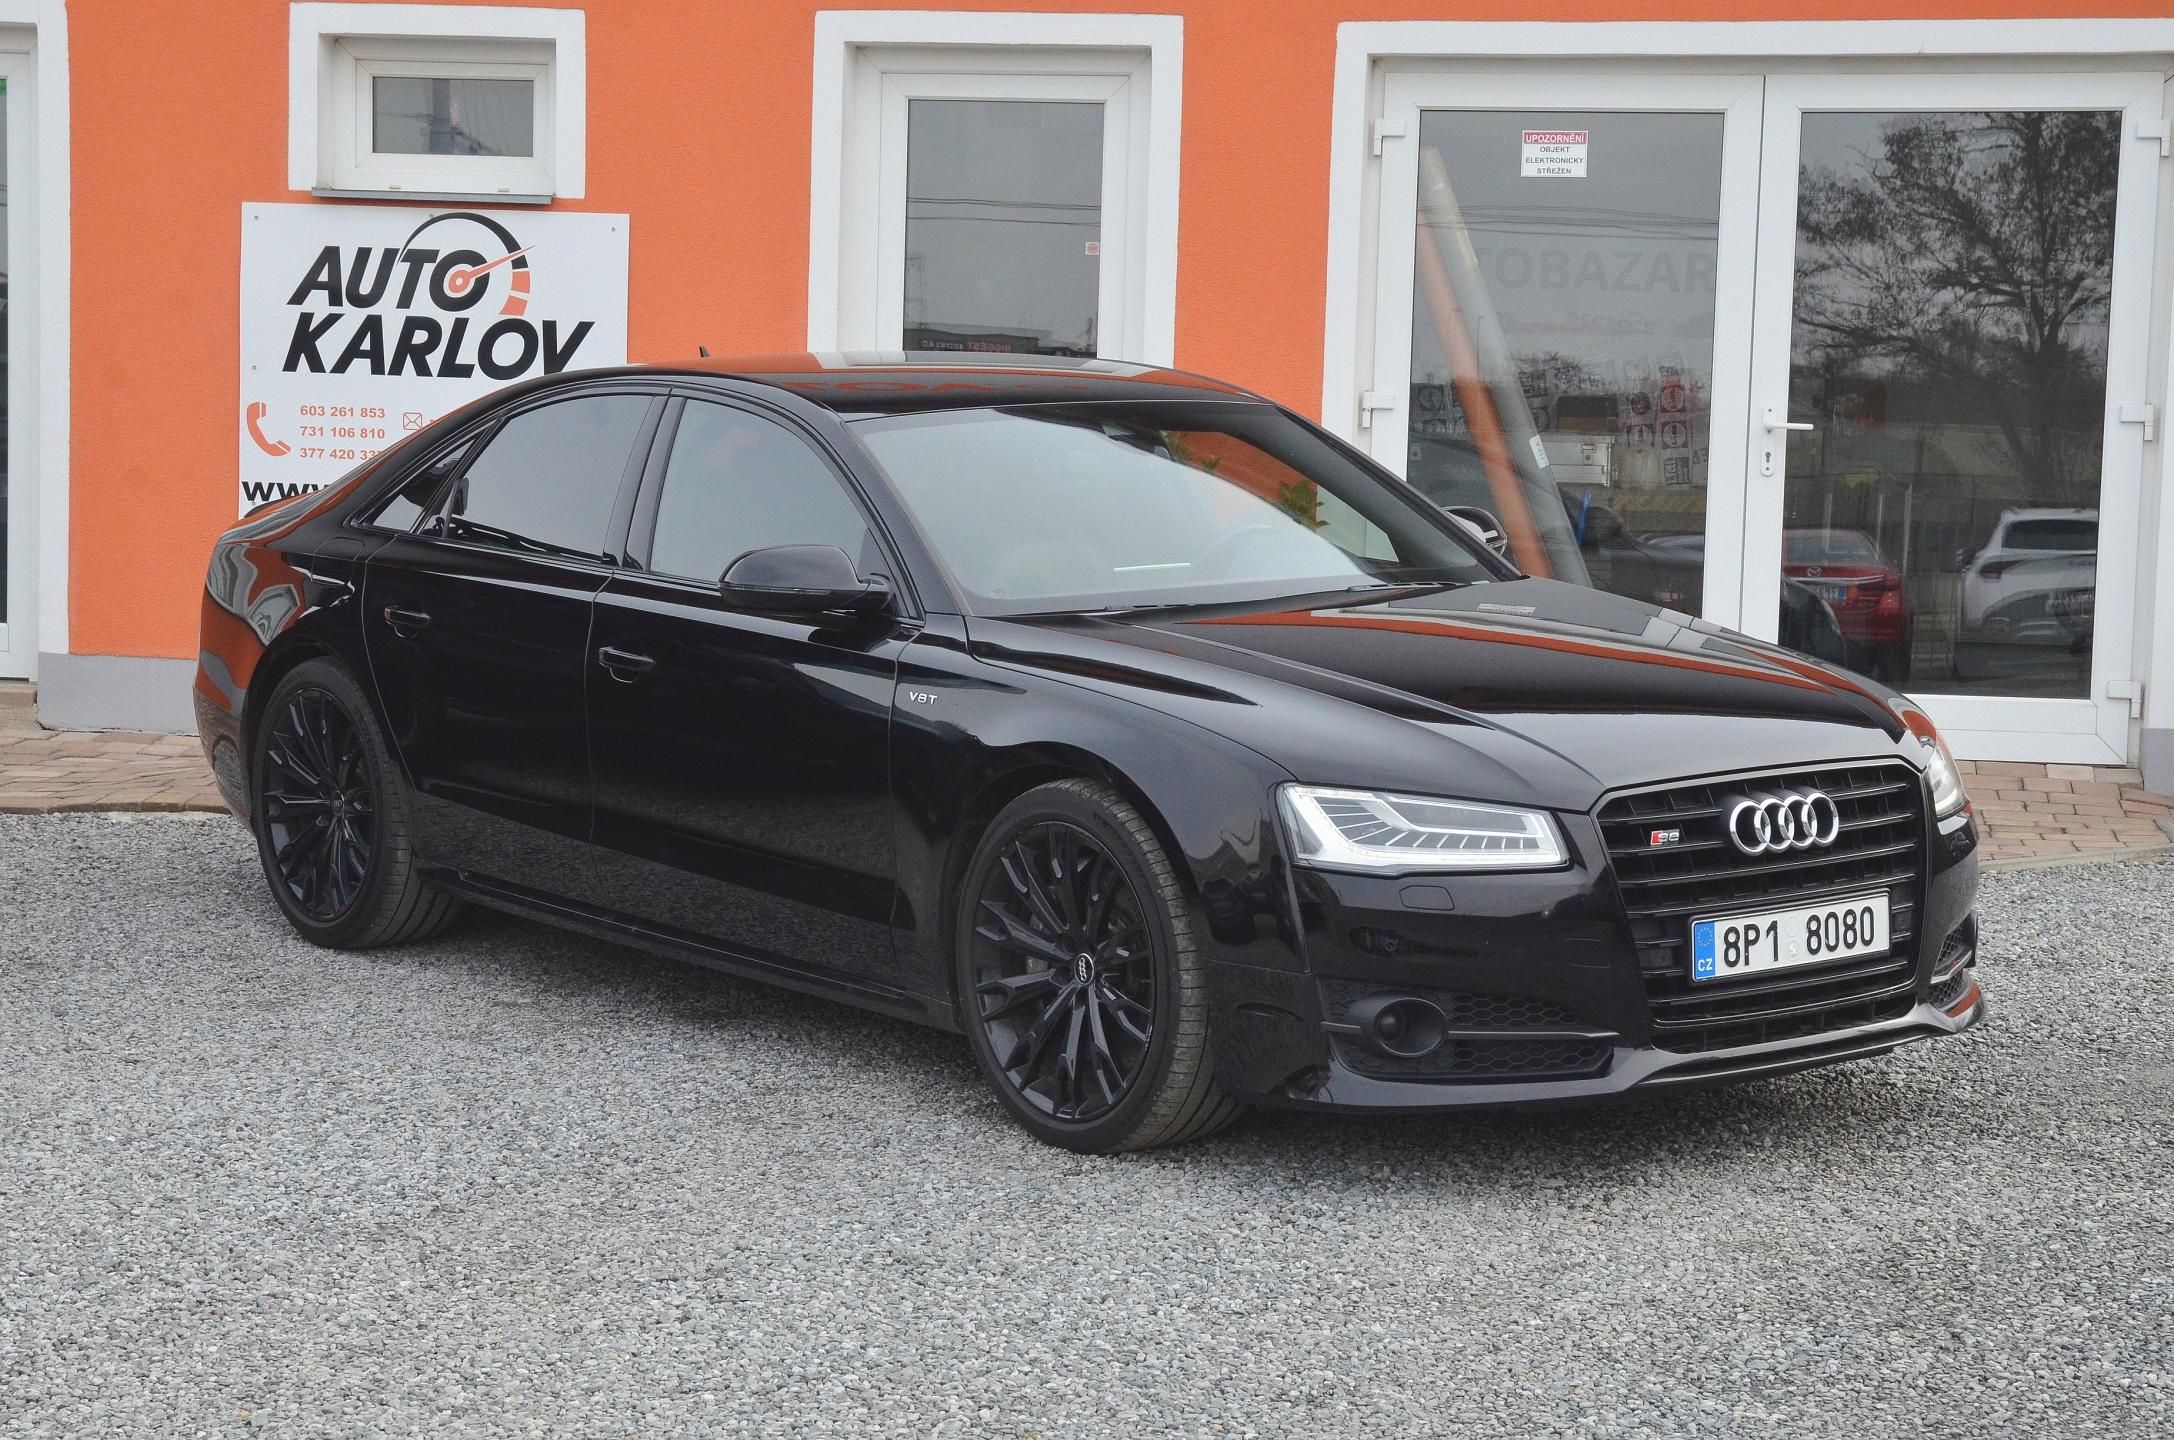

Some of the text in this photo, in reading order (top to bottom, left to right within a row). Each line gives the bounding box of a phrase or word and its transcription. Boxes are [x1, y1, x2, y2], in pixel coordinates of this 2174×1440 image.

[1525, 132, 1585, 143] UPOZORNĚNÍ
[286, 245, 490, 313] AUTO
[282, 312, 596, 380] KARLOV
[300, 405, 385, 419] 603 261 853
[299, 426, 385, 439] 731 106 810
[299, 447, 382, 461] 377 420 33
[909, 691, 938, 705] V8T
[1697, 906, 1875, 973] CZ 8P1 8080
